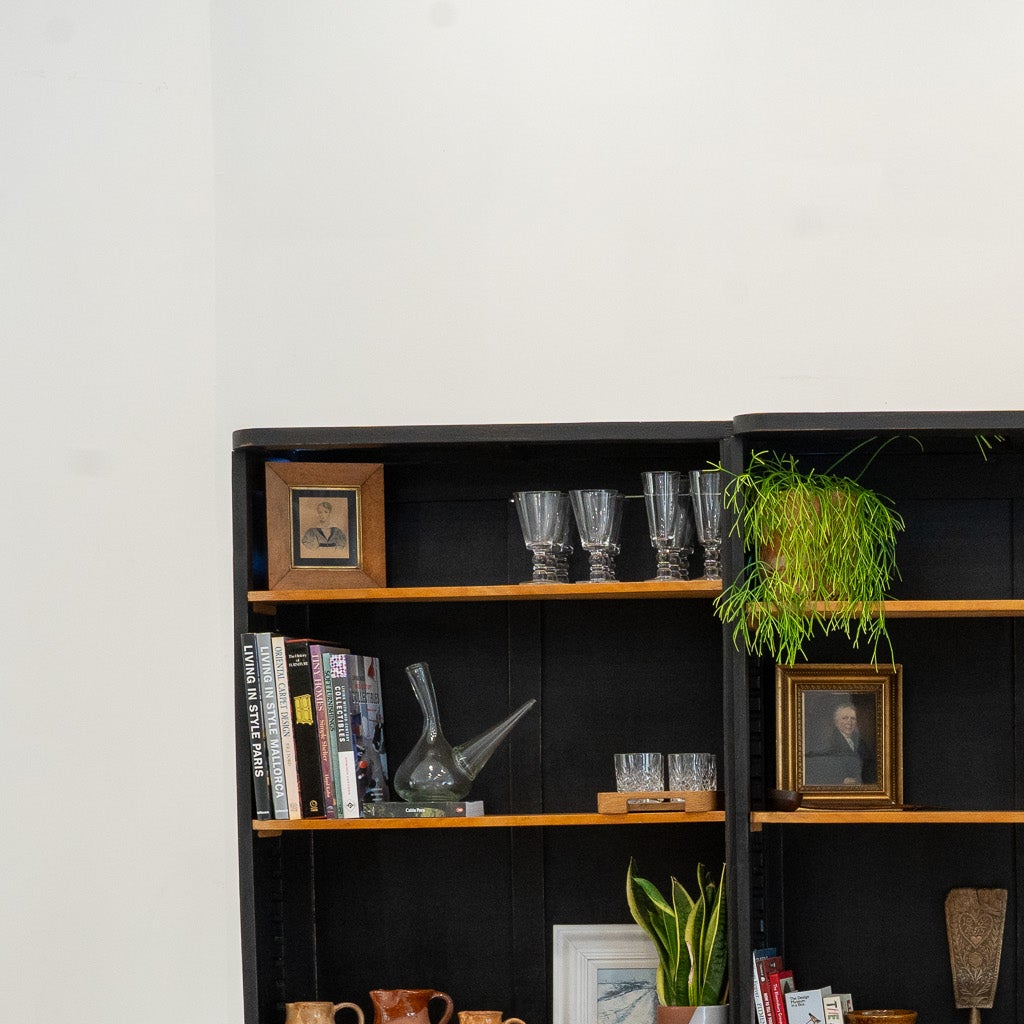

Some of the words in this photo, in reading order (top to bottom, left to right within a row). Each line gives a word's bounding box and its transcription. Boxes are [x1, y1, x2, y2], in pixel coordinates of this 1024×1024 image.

[244, 645, 256, 684] LIVING
[260, 646, 272, 683] LIVING
[274, 646, 285, 680] ORIENTAL
[312, 654, 322, 677] TINY
[247, 688, 257, 697] IN
[264, 687, 274, 698] IN
[278, 683, 288, 709] CARPET
[314, 679, 325, 712] HOMES
[249, 704, 260, 739] STYLE
[266, 702, 278, 735] STYLE
[280, 712, 291, 737] DESIGN
[326, 688, 336, 732] FURNISHINGS
[334, 686, 345, 743] COLLECTIBLES
[318, 719, 327, 740] Simple
[253, 743, 264, 778] PARIS
[321, 741, 329, 762] Shelter
[270, 739, 284, 798] MALLORCA
[774, 991, 782, 1013] Bloomsbury
[825, 1000, 839, 1021] THE
